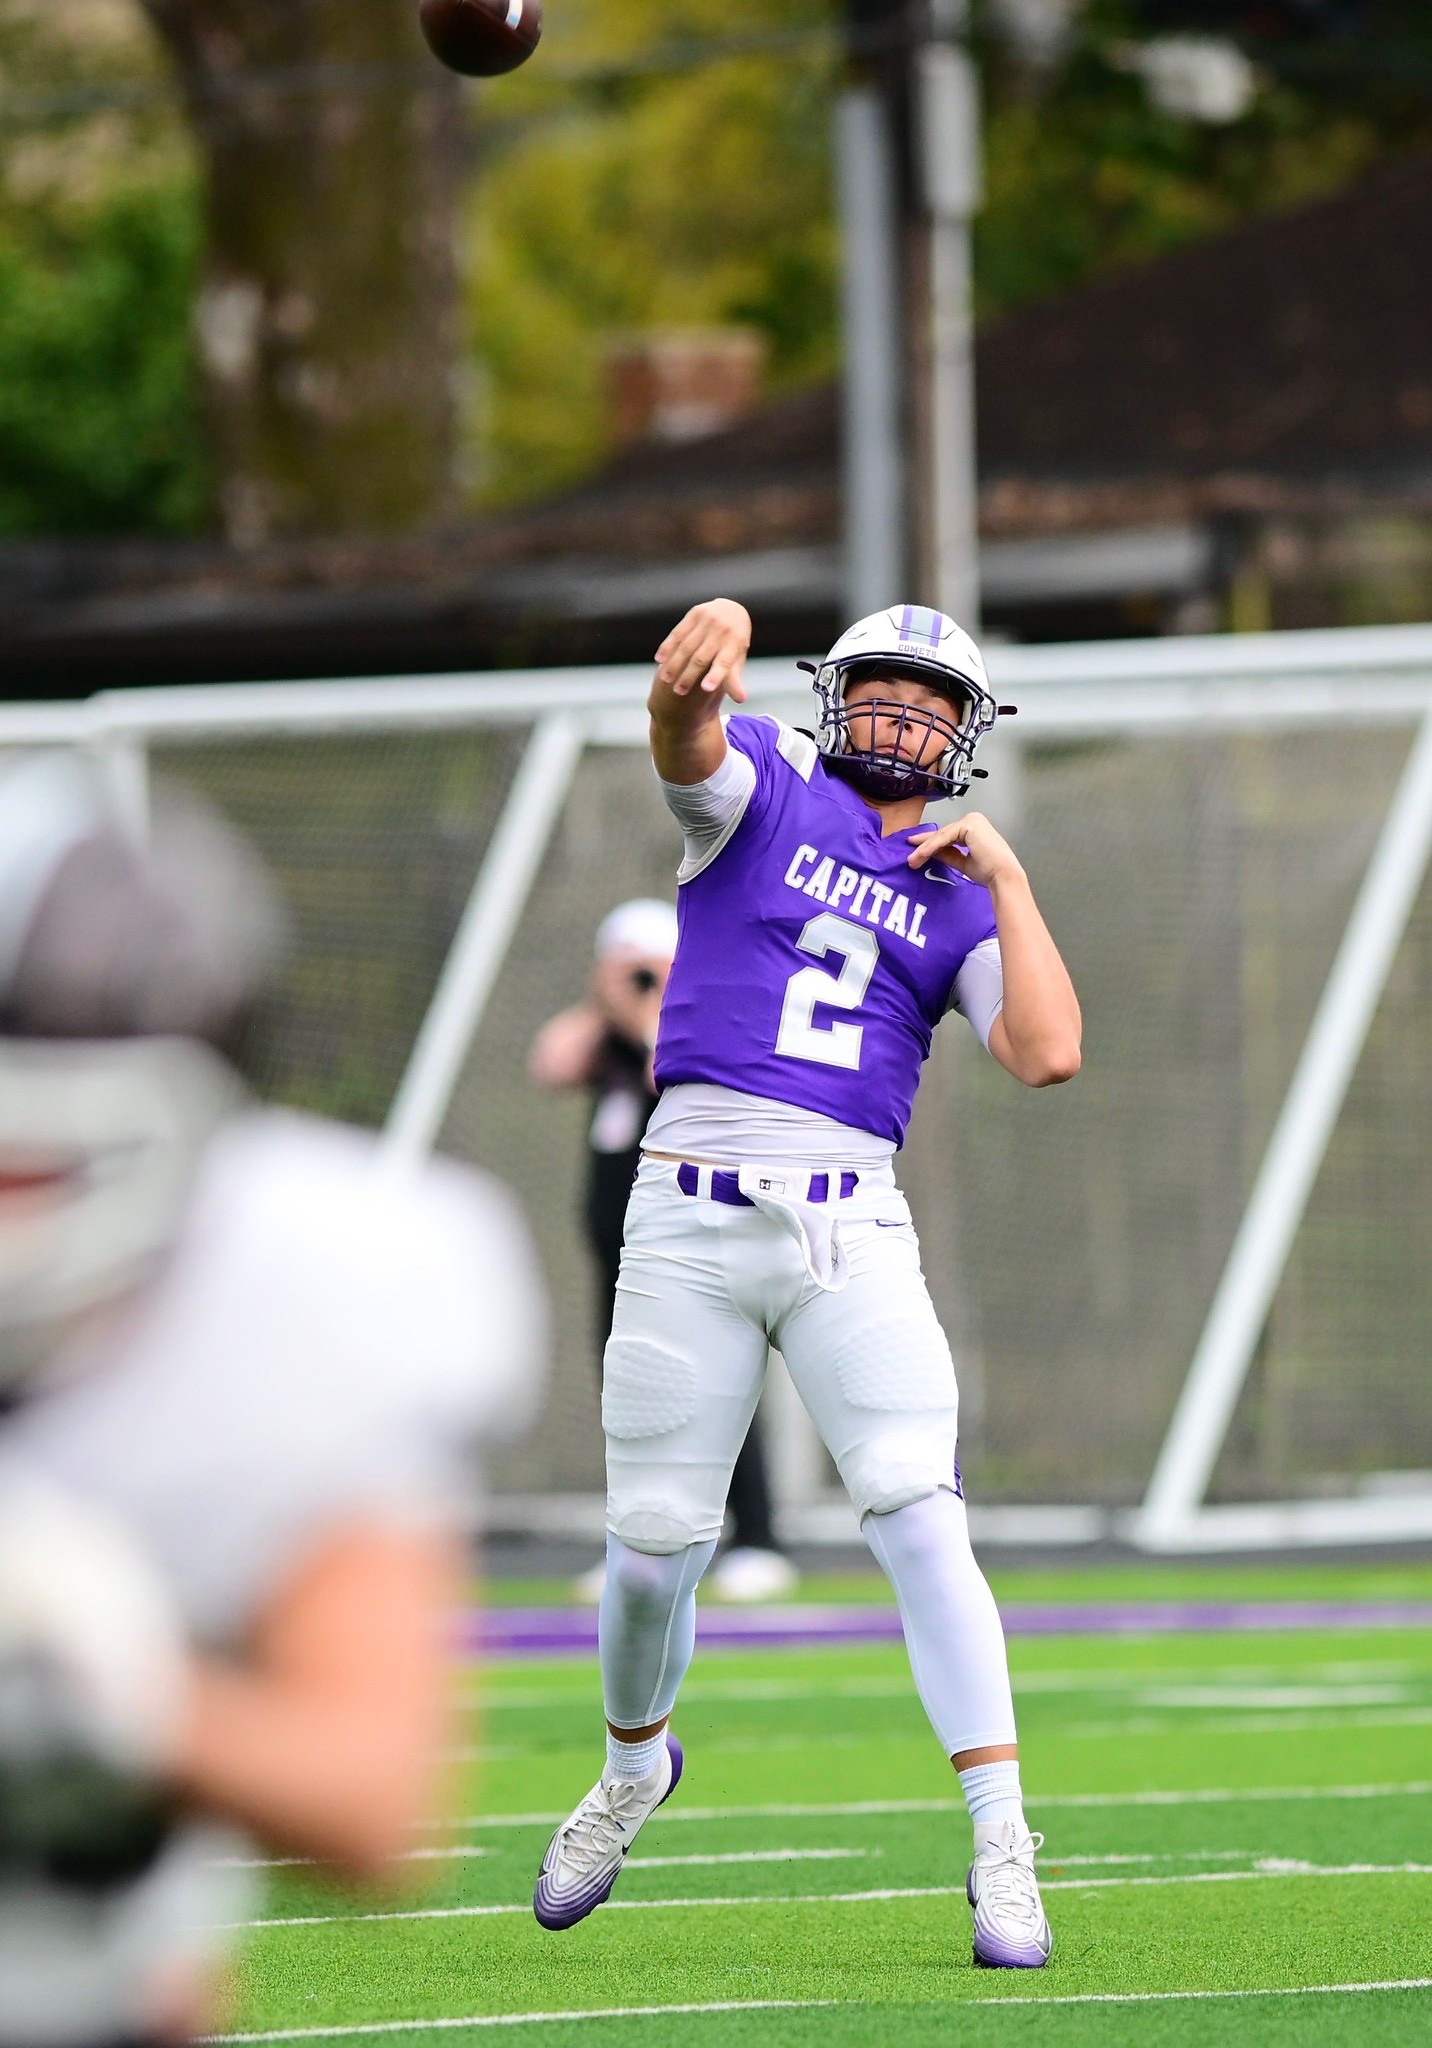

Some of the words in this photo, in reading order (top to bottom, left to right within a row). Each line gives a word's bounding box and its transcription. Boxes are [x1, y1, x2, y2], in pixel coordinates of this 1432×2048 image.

[898, 644, 937, 659] COMETS
[783, 843, 928, 949] CAPITAL
[774, 910, 880, 1071] 2
